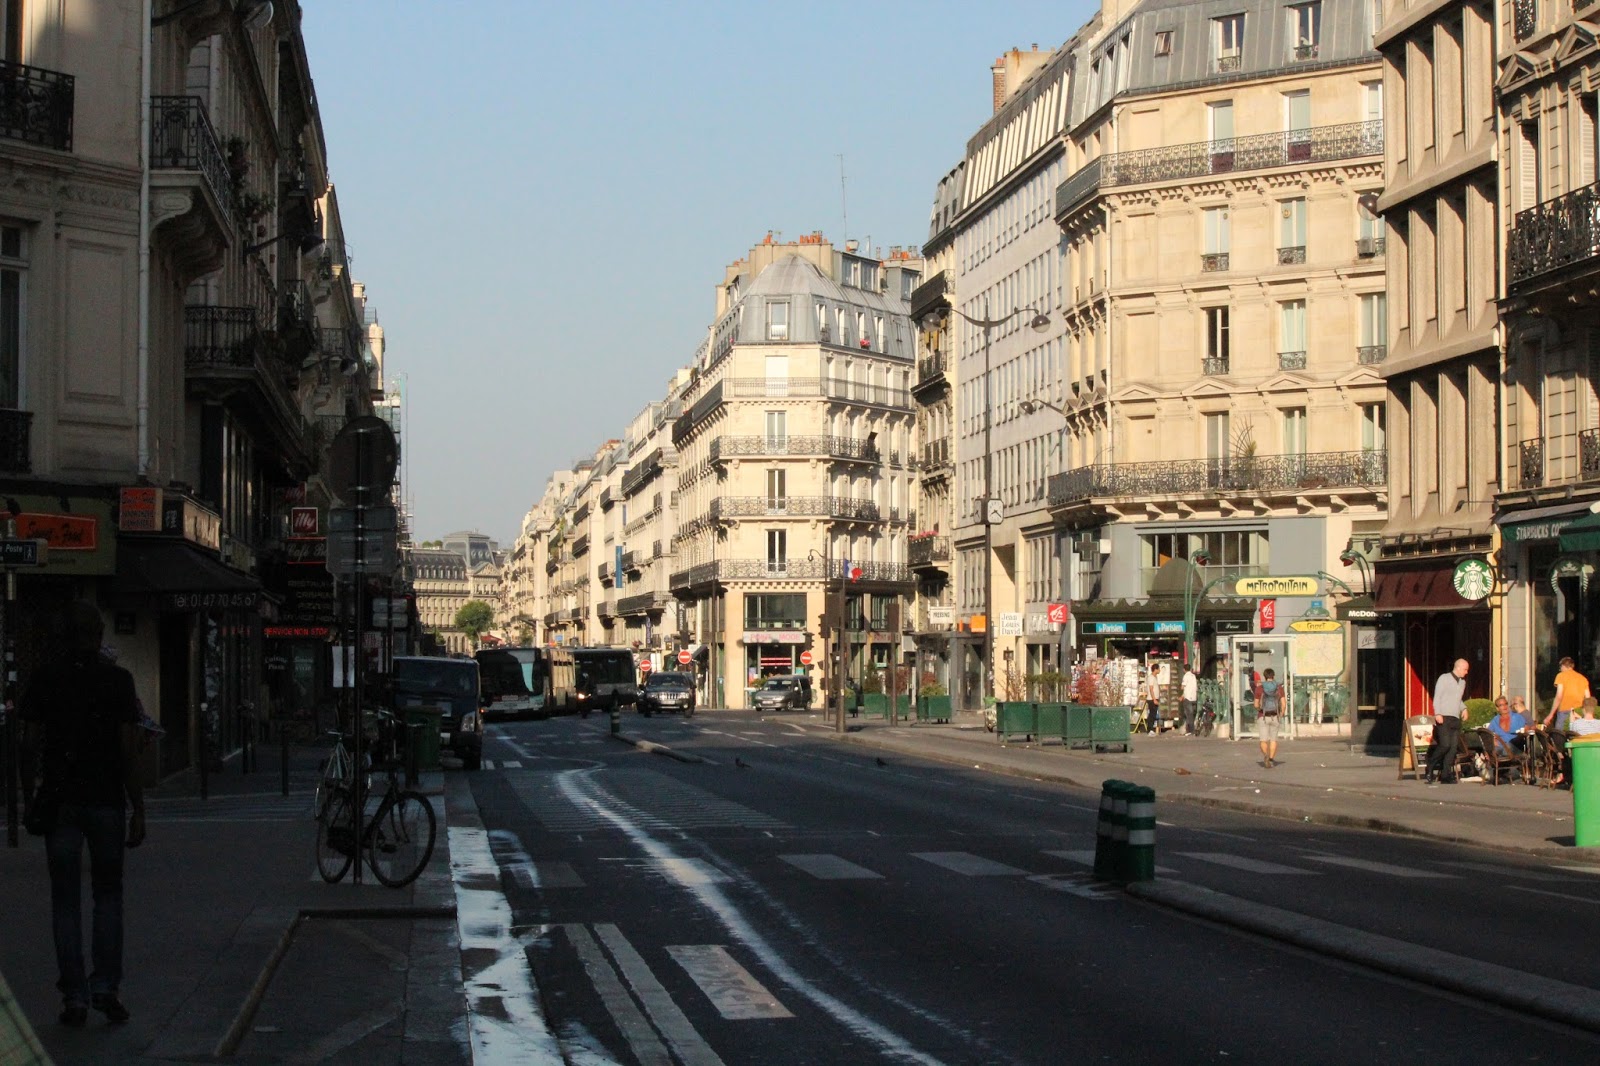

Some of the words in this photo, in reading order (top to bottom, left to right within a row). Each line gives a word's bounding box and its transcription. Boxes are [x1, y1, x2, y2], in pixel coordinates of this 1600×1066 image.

[295, 512, 316, 529] illy
[1516, 524, 1549, 541] STARBUCKS
[5, 543, 23, 554] Poste
[1246, 579, 1308, 594] METROPOLITAIN
[1001, 613, 1018, 621] Jean
[1001, 620, 1020, 628] Louis
[1103, 623, 1124, 632] Parisien
[1161, 622, 1183, 632] Parisien
[294, 627, 309, 636] NON
